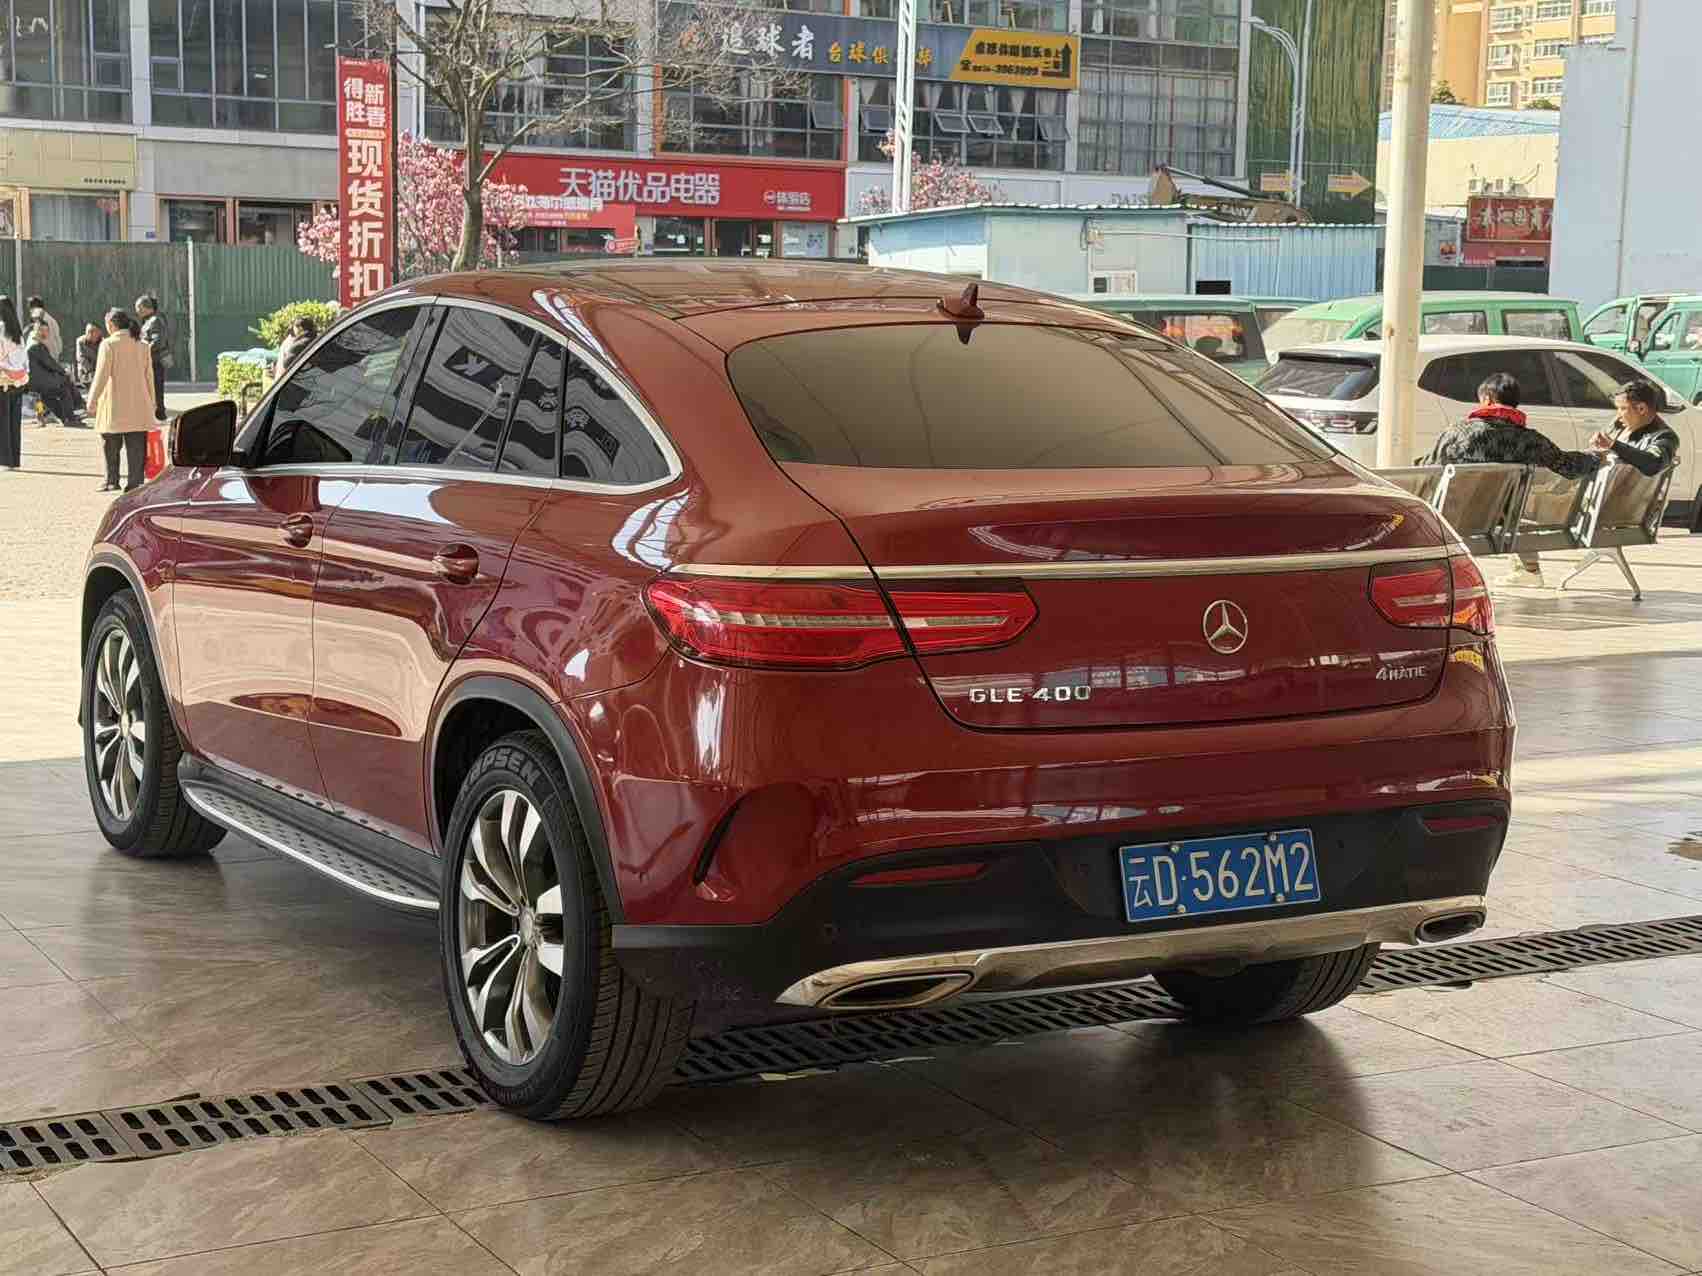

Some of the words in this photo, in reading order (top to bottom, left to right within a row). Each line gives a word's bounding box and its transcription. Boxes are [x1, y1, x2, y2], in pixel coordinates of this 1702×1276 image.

[829, 41, 932, 66] 台球俱部
[344, 77, 366, 122] 得胜
[559, 167, 720, 205] 天猫优品电器
[347, 139, 385, 298] 现货折扣
[969, 687, 1024, 703] GLE
[1032, 685, 1091, 701] 400
[1127, 841, 1314, 907] 云D·562M2
